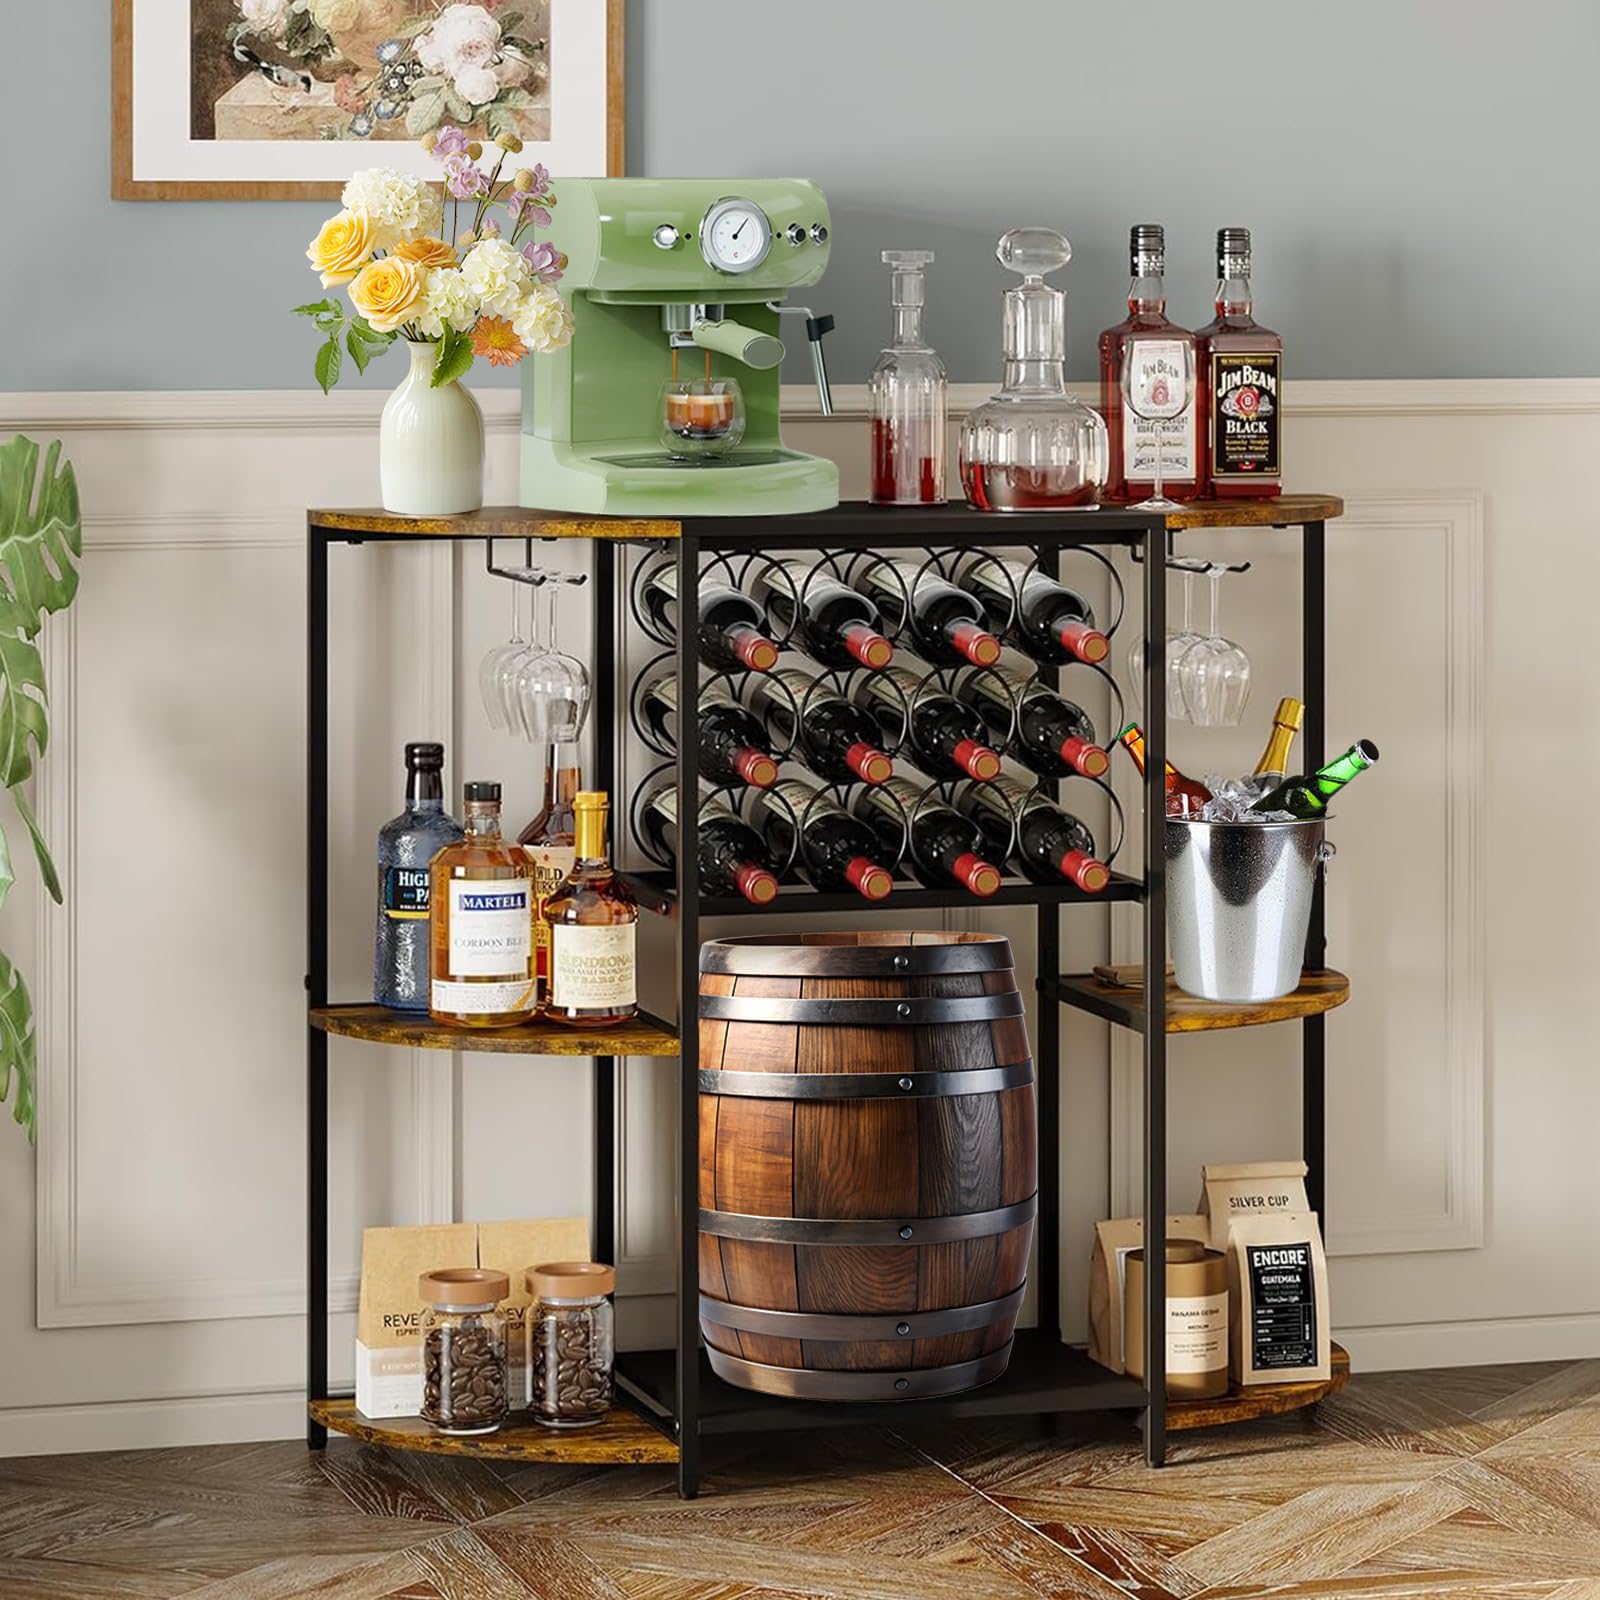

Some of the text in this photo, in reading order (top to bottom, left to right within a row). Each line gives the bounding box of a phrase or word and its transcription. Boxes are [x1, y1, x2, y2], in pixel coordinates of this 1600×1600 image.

[1216, 364, 1277, 398] JIM BEAM
[1225, 419, 1269, 434] BLACK
[462, 895, 524, 910] MARTELL
[454, 937, 504, 949] CORDON
[1229, 1194, 1289, 1208] SILVER CUP
[1252, 1249, 1307, 1268] ENCORE
[1171, 1310, 1201, 1318] PANAMA
